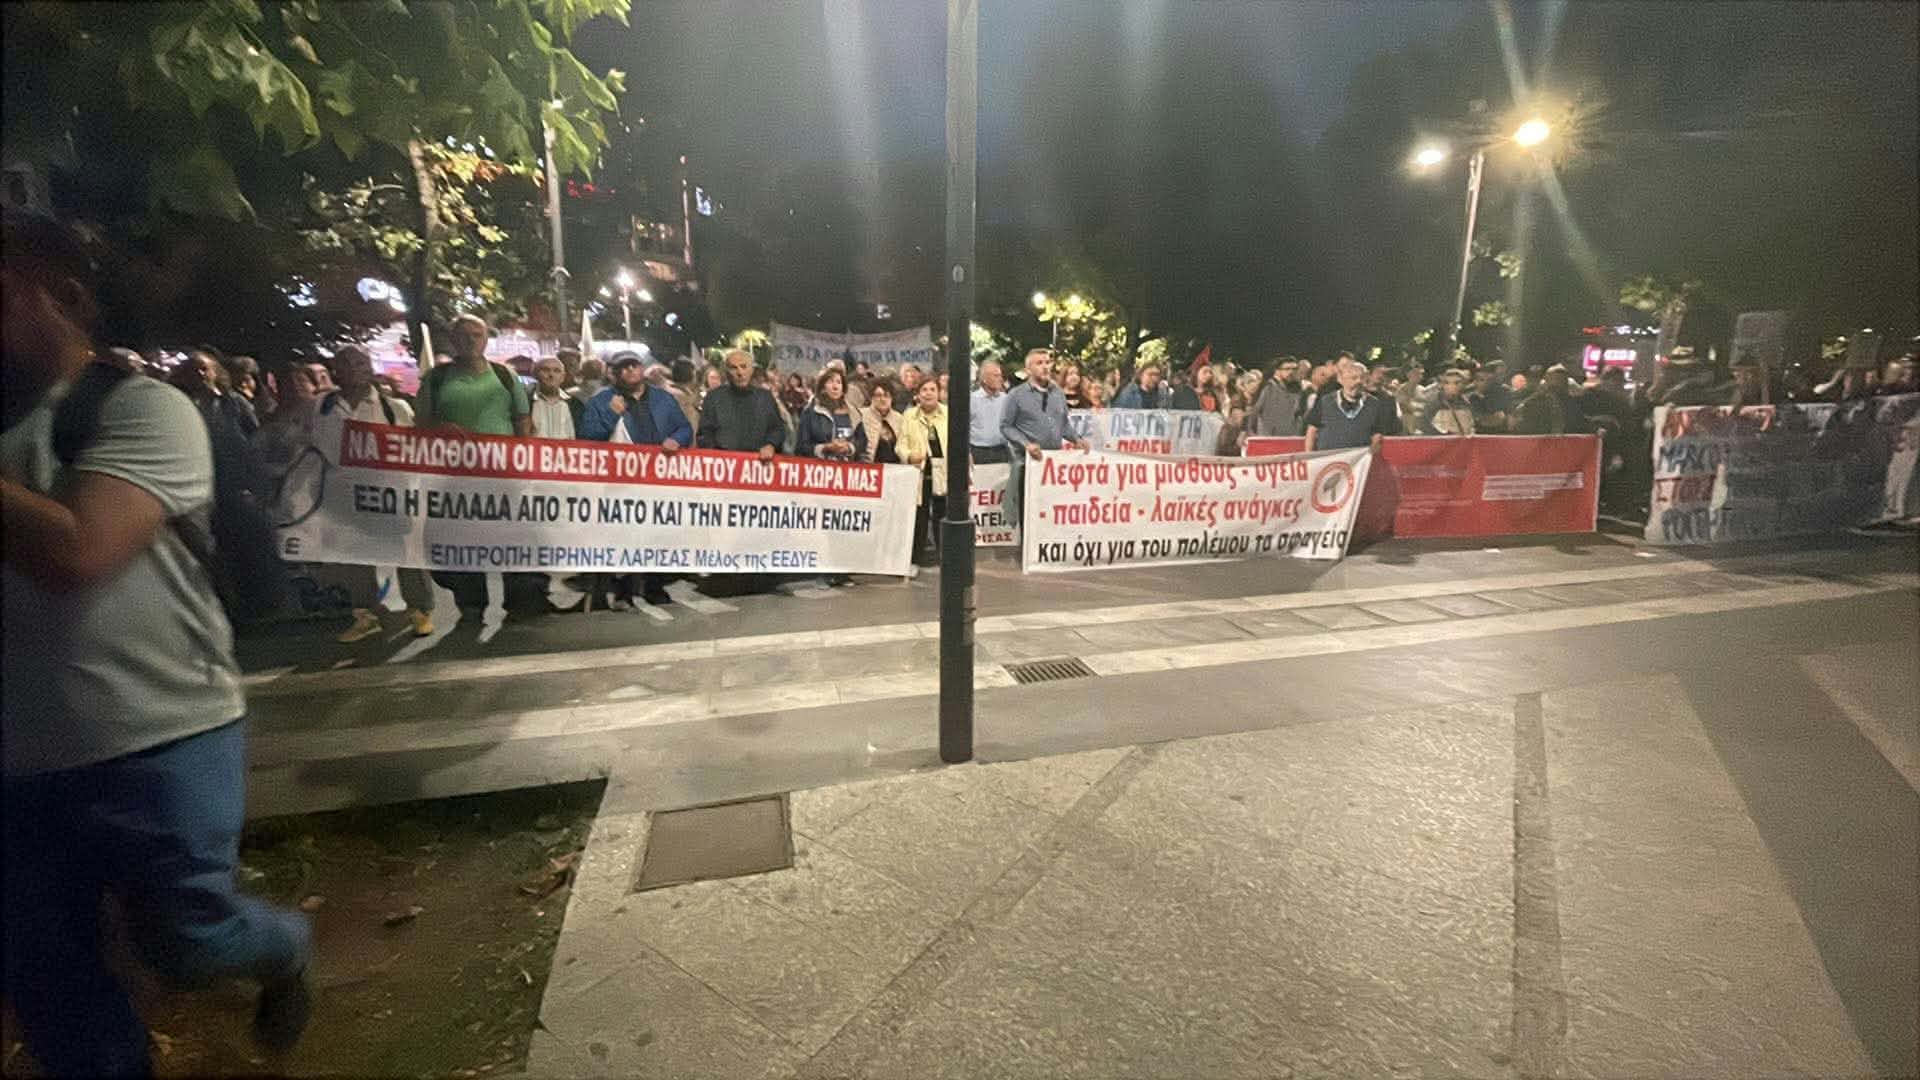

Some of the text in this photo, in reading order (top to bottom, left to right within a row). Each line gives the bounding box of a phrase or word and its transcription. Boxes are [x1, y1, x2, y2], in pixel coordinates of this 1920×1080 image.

[349, 430, 879, 492] ΝΑ ΞΗΛΩΘΟΥΝ ΟΙ ΒΑΣΕΙΣ ΤΟΥ ΘΑΝΑΤΟΥ ΑΠΟ ΤΗ ΧΩΡΑ ΜΑΣ
[1041, 456, 1109, 492] Λεφτά
[1116, 463, 1148, 492] για
[1155, 457, 1237, 491] μισθούς
[355, 484, 871, 532] ΕΞΩ Η ΕΛΛΑΔΑ ΑΠΟ ΤΟ ΝΑΤΟ ΚΑΙ ΤΗΝ ΕΥΡΩΠΑΪΚΗ ΕΝΩΣΗ
[1053, 496, 1131, 525] παιδεία
[1150, 494, 1219, 528] λαϊκές
[1223, 492, 1302, 525] ανάγκες
[432, 544, 818, 569] ΕΠΙΤΡΟΠΗ ΕΙΡΗΝΗΣ ΛΑΡΙΣΑΣ Μέλος της ΕΕΔΥΕ
[1039, 542, 1067, 562] και
[1074, 534, 1102, 566] όχι
[1108, 540, 1135, 563] για
[1141, 539, 1171, 558] του
[1177, 530, 1250, 558] πολέμου
[1255, 534, 1273, 553] τα
